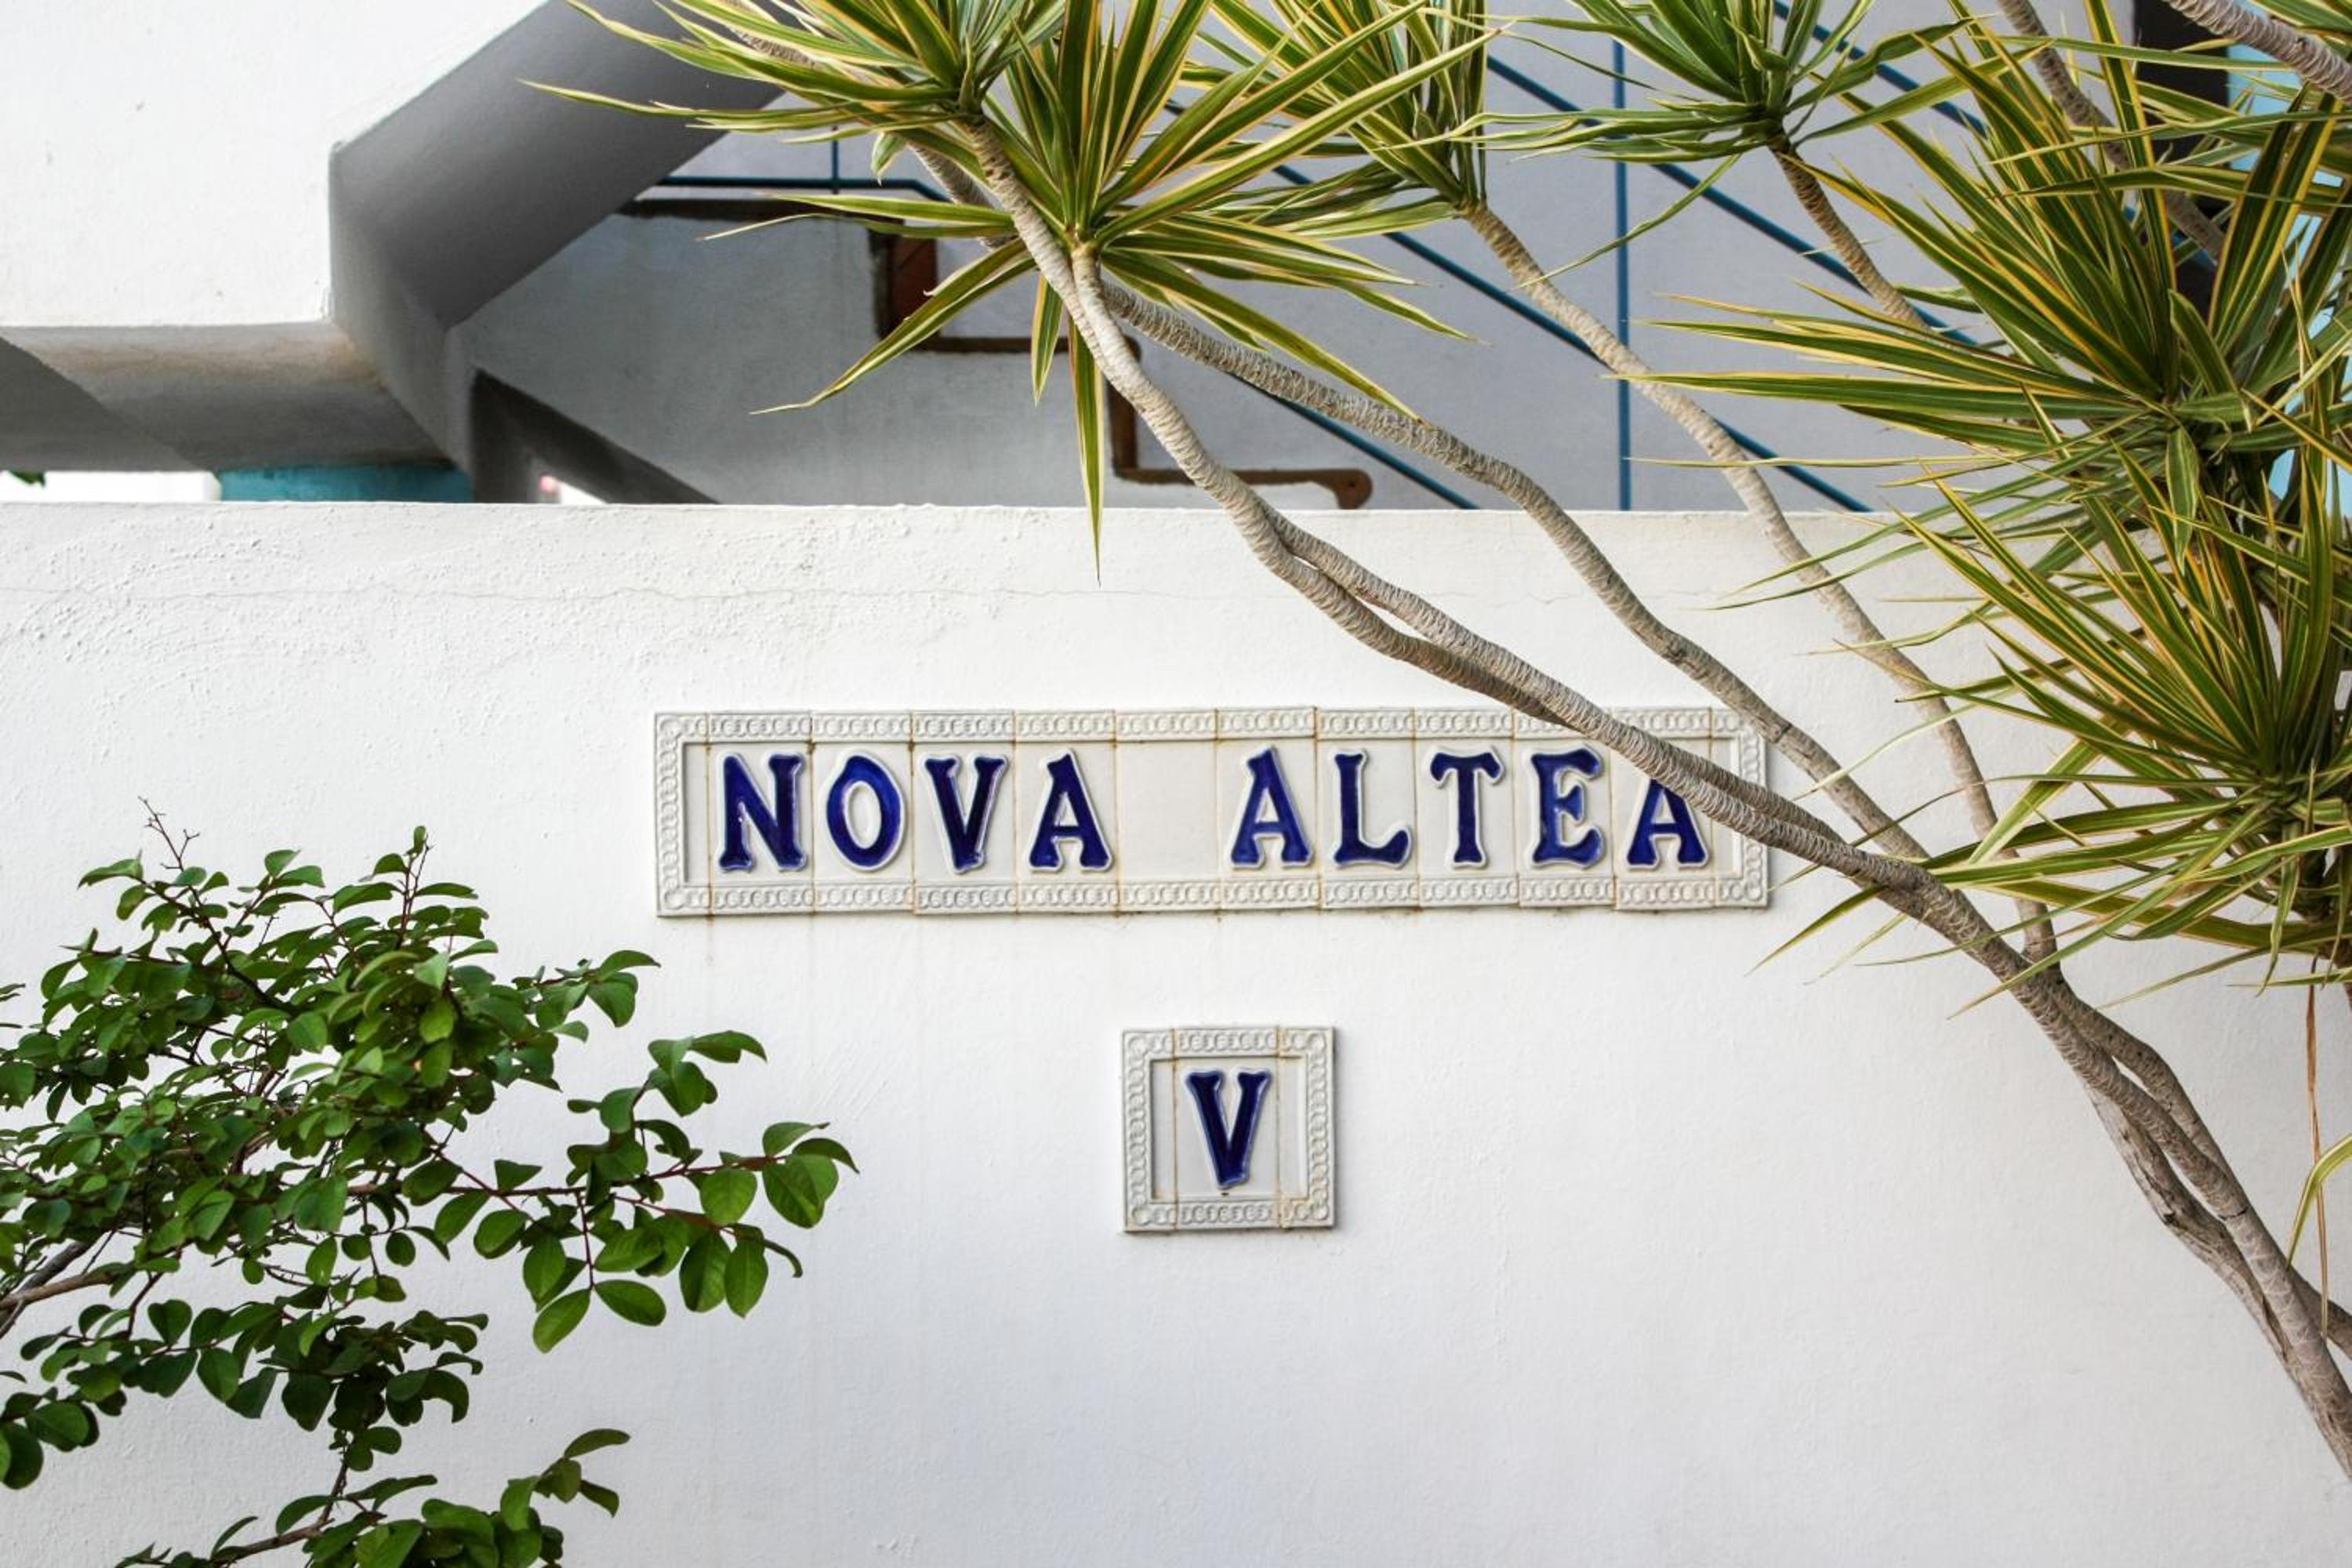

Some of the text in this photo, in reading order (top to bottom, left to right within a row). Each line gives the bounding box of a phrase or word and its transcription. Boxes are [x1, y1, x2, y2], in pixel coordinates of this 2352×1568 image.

[717, 747, 1709, 872] NOVA ALTEA
[1186, 1070, 1272, 1188] V
